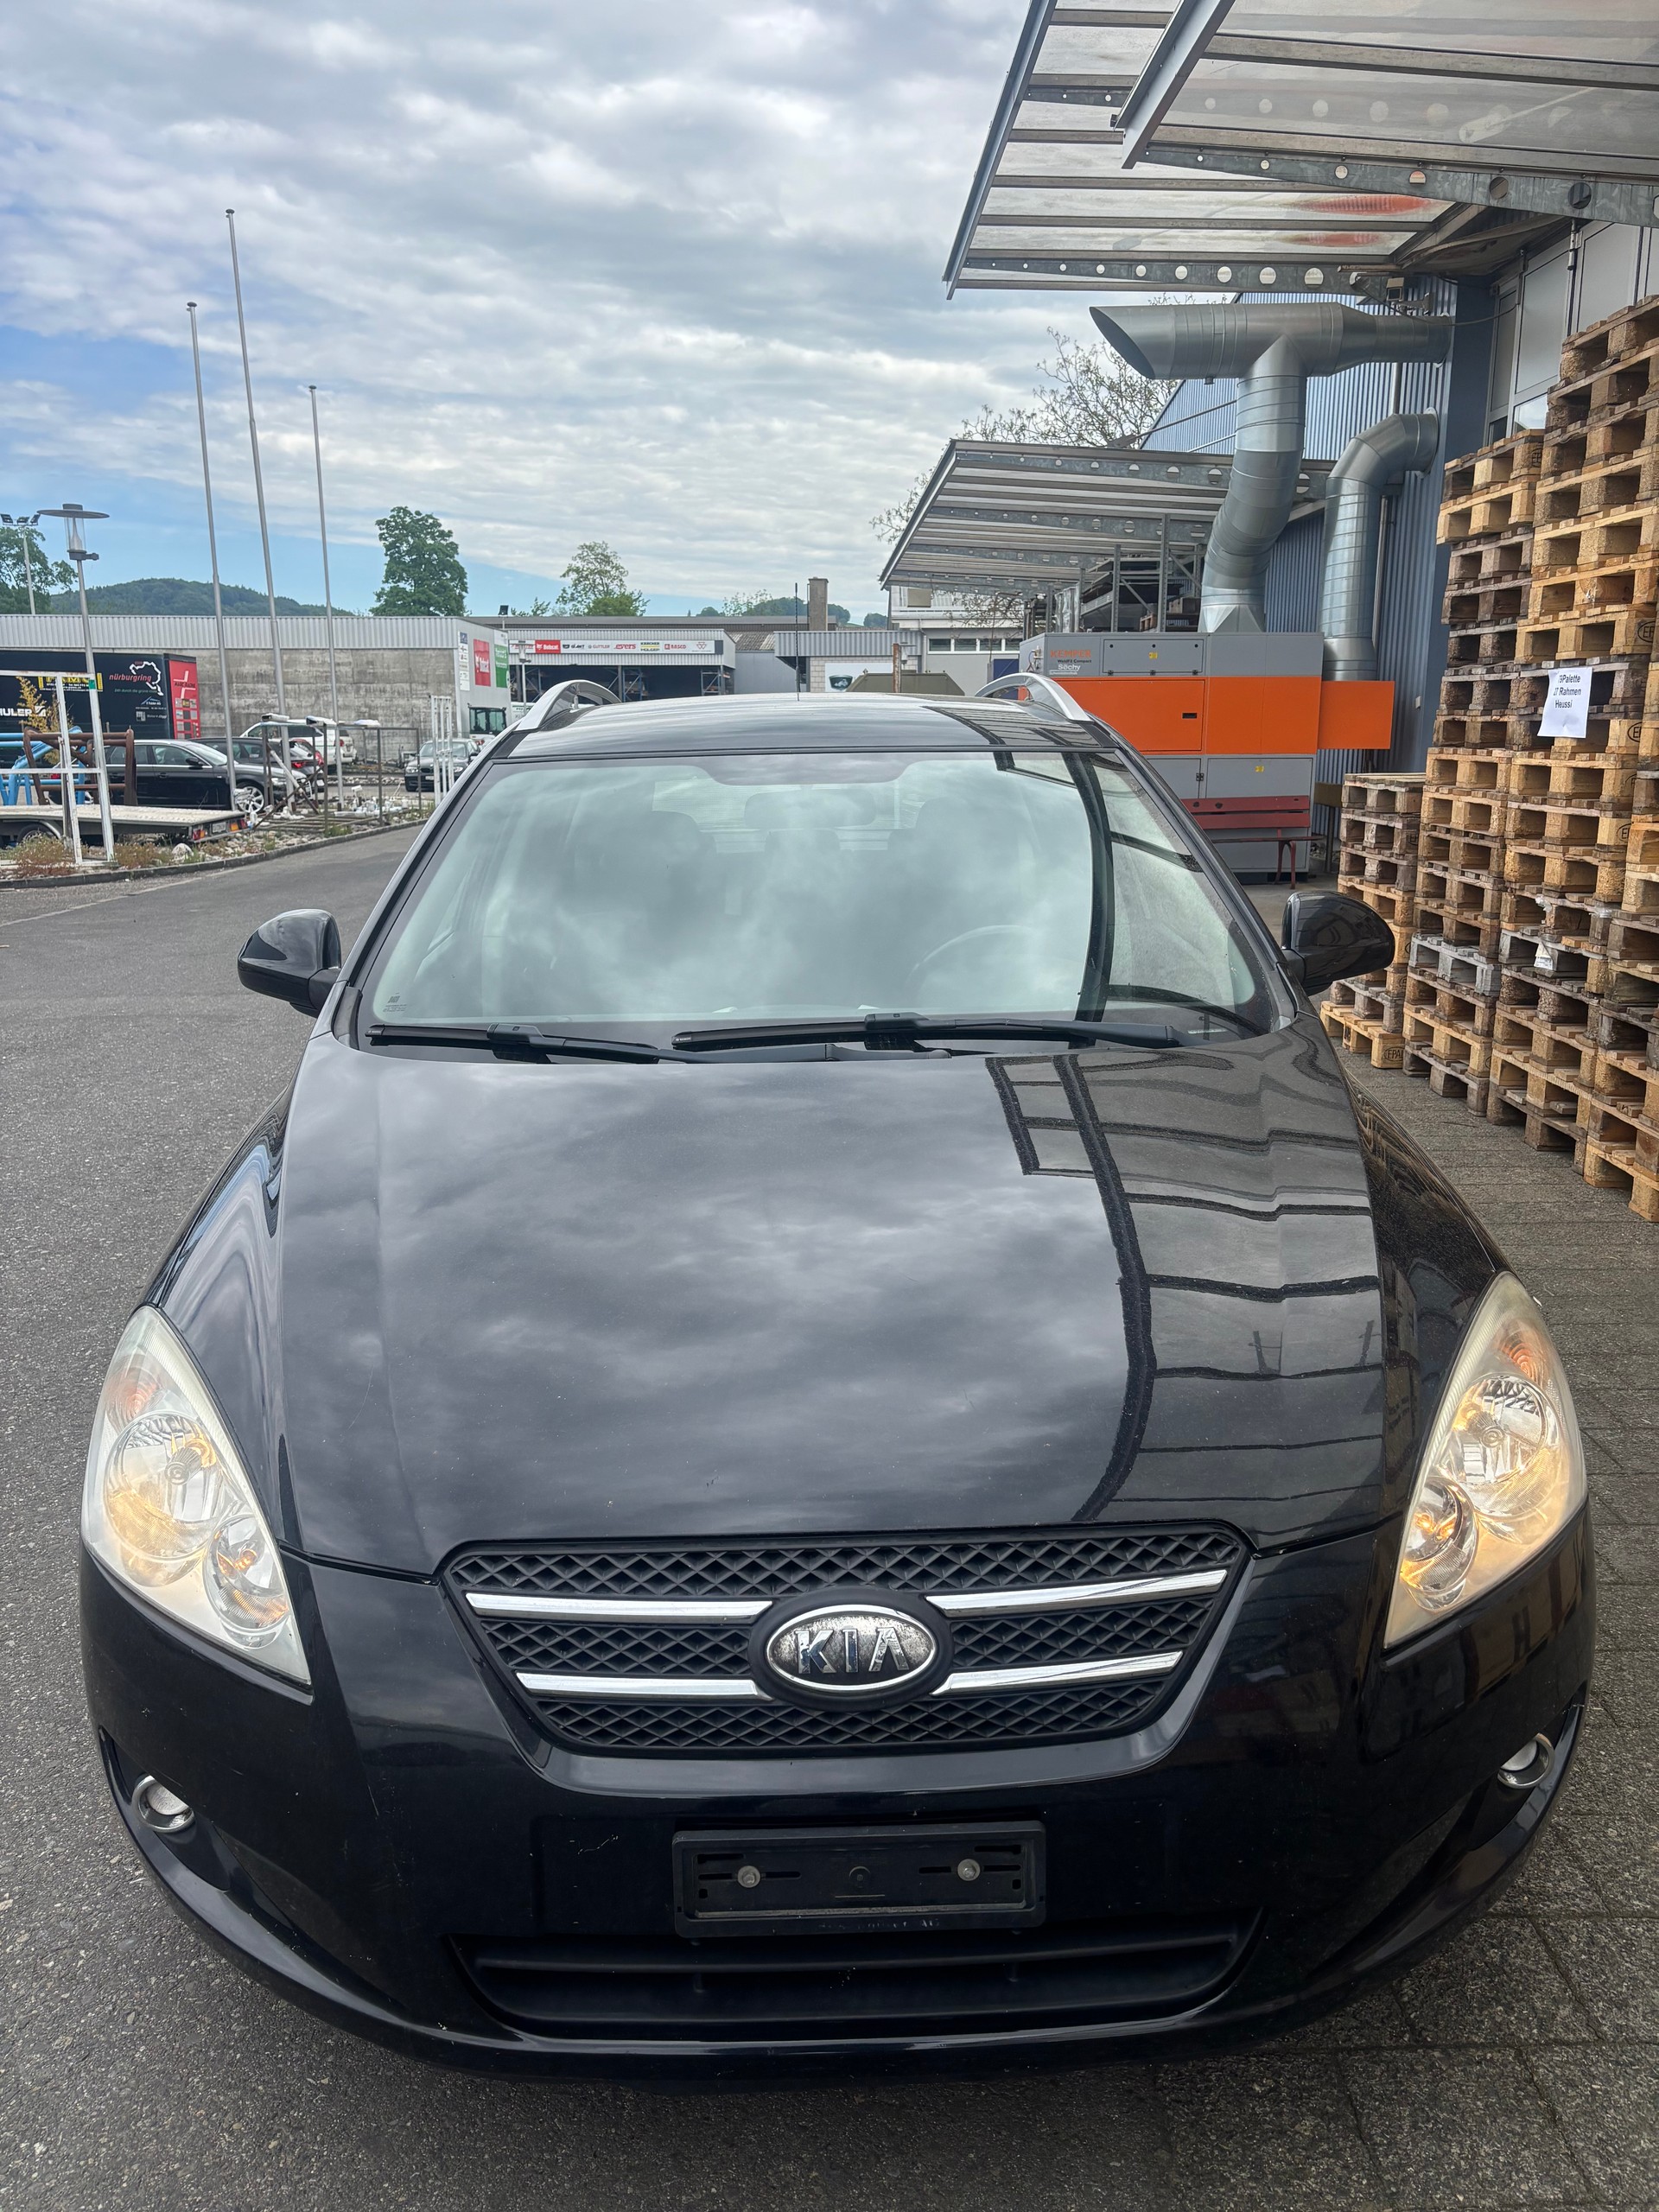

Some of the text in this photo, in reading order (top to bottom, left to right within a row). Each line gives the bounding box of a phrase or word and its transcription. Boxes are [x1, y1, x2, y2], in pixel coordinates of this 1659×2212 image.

[1050, 649, 1091, 658] KEMPER
[109, 673, 152, 683] nürburgring
[1559, 686, 1582, 696] Rahmen
[1554, 699, 1573, 709] Heussi
[794, 1626, 910, 1675] KIA
